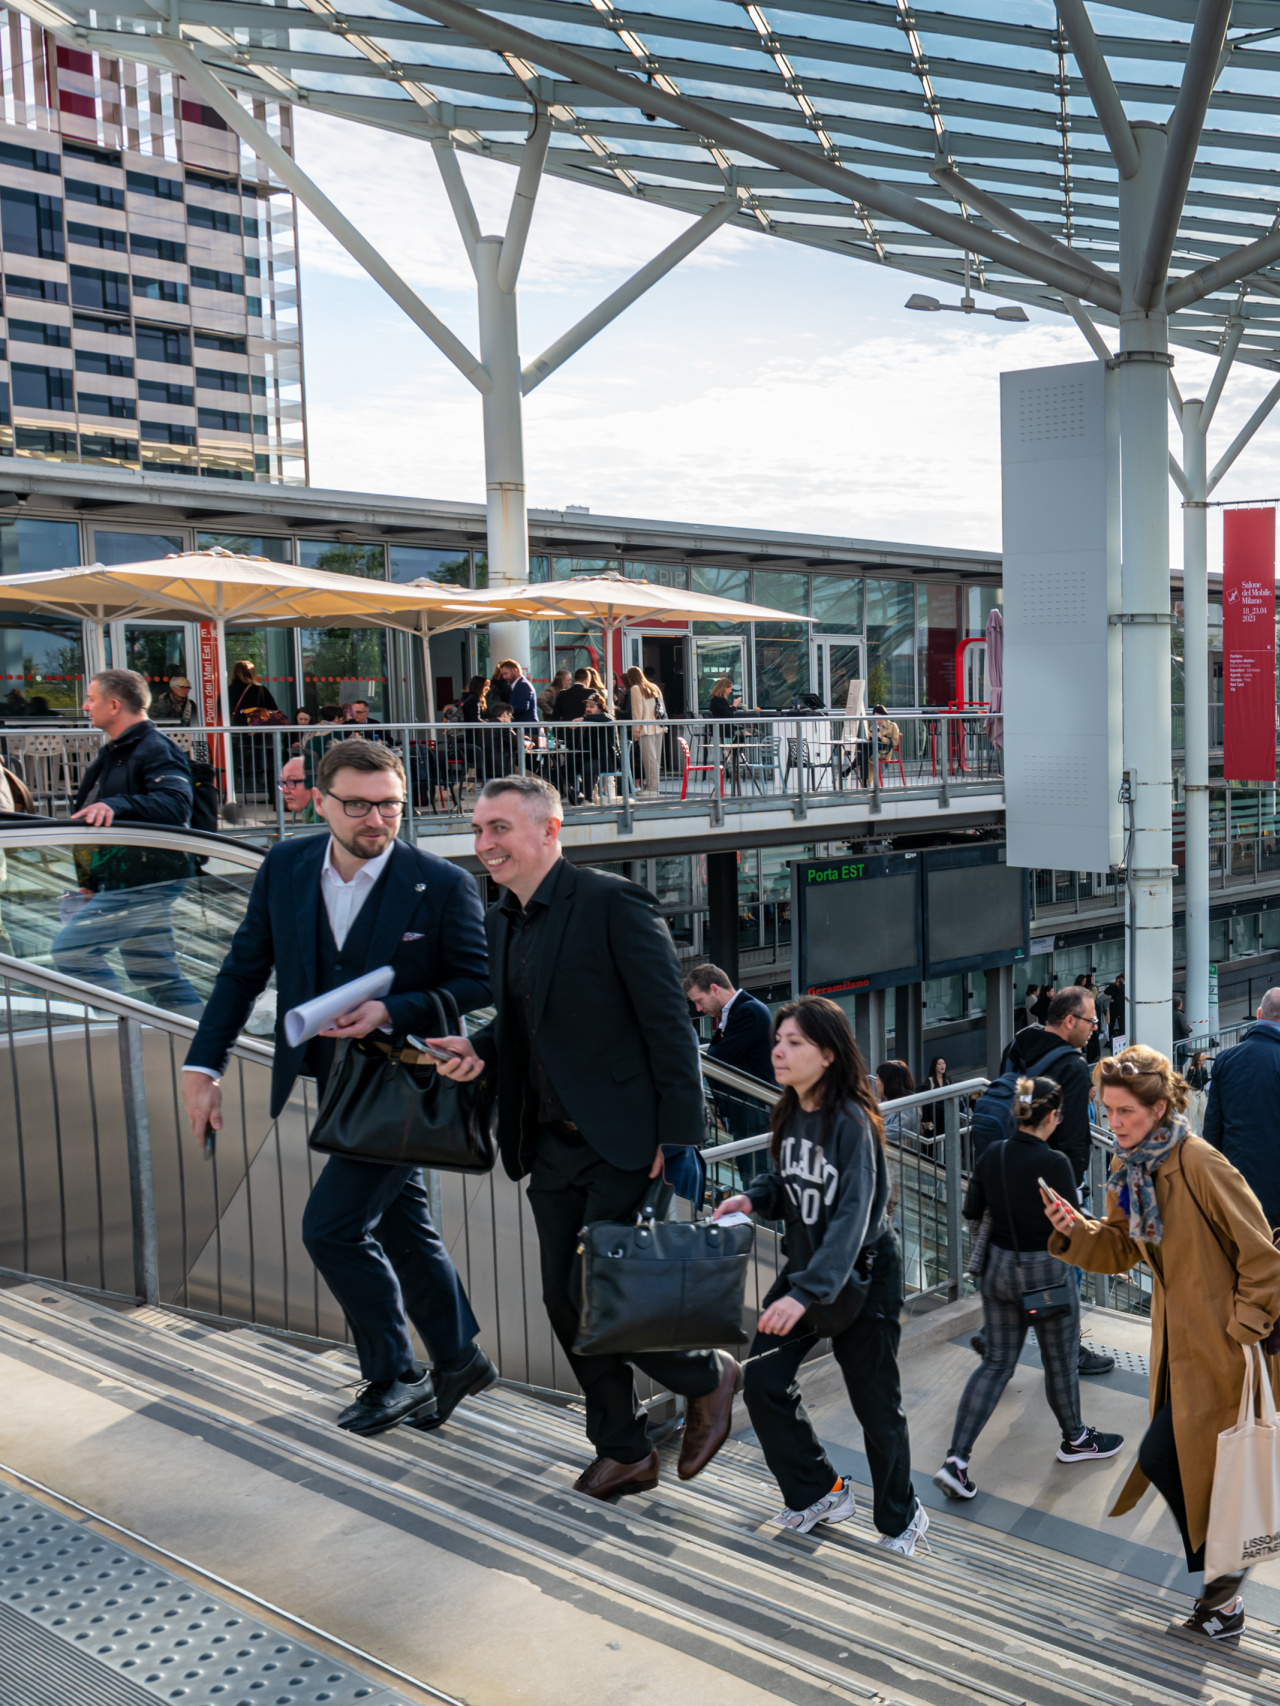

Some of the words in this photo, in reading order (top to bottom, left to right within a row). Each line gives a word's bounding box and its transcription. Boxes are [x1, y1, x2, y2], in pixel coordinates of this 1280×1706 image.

[1242, 580, 1262, 588] Salone
[1242, 588, 1252, 596] del
[1252, 588, 1272, 596] Mobile.
[1243, 607, 1267, 615] 18_23.04
[202, 645, 211, 659] Est
[204, 662, 212, 680] Mari
[206, 699, 215, 723] Ponte
[808, 868, 839, 883] Porta
[842, 864, 865, 879] EST
[807, 980, 870, 996] fieramilano
[1202, 1616, 1224, 1636] N
